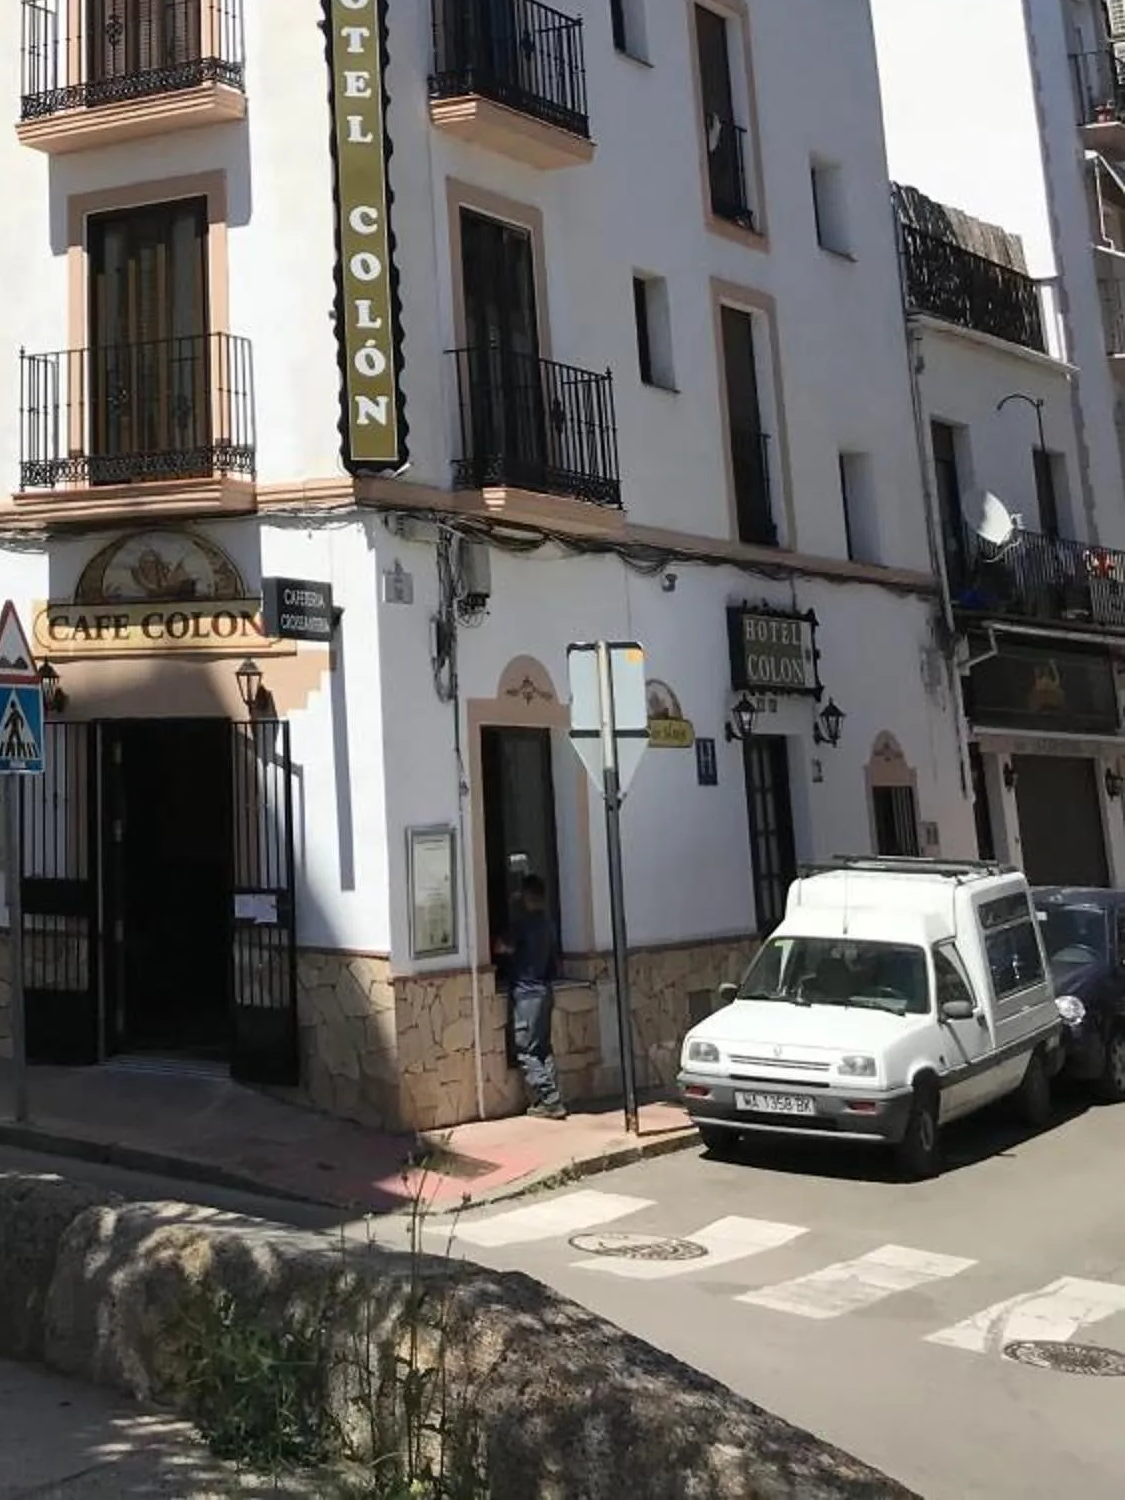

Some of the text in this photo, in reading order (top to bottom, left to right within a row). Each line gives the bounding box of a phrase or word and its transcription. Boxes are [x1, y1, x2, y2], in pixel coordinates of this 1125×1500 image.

[348, 205, 389, 425] COLÓN
[48, 613, 129, 641] CAFE
[141, 610, 266, 640] COLON
[746, 619, 800, 645] HOTEL
[748, 654, 805, 684] COLON
